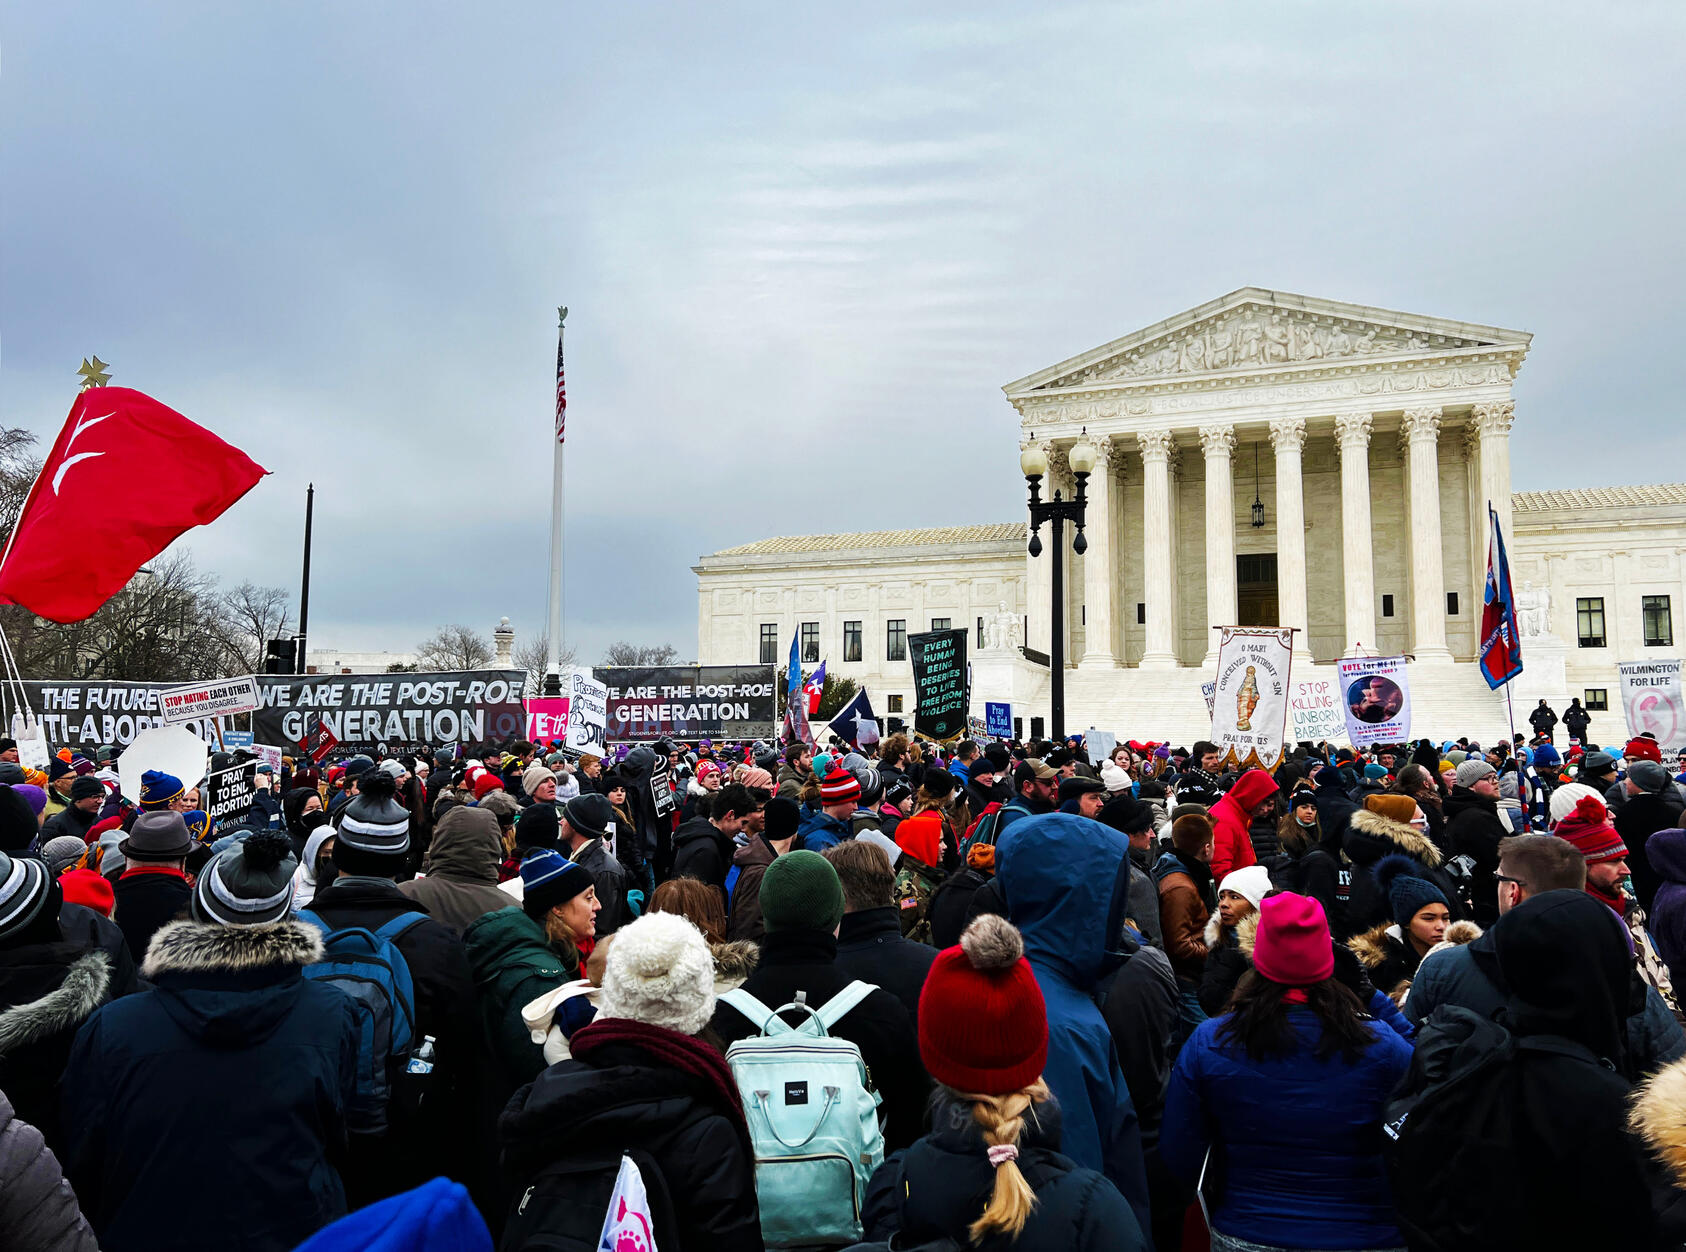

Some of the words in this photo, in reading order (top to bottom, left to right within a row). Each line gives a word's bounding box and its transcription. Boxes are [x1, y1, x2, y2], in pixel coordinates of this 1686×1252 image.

[924, 638, 952, 652] EVERY
[924, 649, 955, 663] HUMAN
[927, 660, 952, 674] BEING
[1342, 664, 1361, 672] VOTE
[1620, 664, 1680, 675] WILMINGTON
[921, 669, 960, 686] DESERVES
[1220, 656, 1246, 691] CONCEIVED
[1250, 654, 1278, 677] WITHOUT
[1273, 681, 1282, 696] SIN
[1630, 677, 1648, 686] FOR
[1650, 676, 1670, 686] LIFE
[257, 685, 291, 707] WE
[296, 684, 344, 706] ARE
[350, 683, 393, 705] THE
[396, 680, 524, 705] POST-ROE
[624, 687, 656, 699] ARE
[661, 685, 691, 698] THE
[696, 684, 773, 698] POST-ROE
[926, 687, 937, 696] TO
[940, 680, 956, 692] LIVE
[1299, 681, 1328, 695] STOP
[41, 688, 80, 710] THE
[86, 688, 160, 711] FUTURE
[165, 697, 183, 707] STOP
[184, 691, 209, 704] HATING
[210, 687, 228, 699] EACH
[228, 684, 251, 696] OTHER
[921, 696, 940, 708] FREE
[942, 690, 962, 702] FROM
[1292, 696, 1332, 709] KILLING
[167, 706, 194, 716] BECAUSE
[195, 703, 208, 711] YOU
[616, 703, 749, 722] GENERATION
[921, 701, 962, 716] VIOLENCE
[992, 704, 1004, 716] Pray
[990, 716, 995, 724] to
[997, 716, 1007, 726] End
[1294, 710, 1340, 724] UNBORN
[988, 725, 1010, 736] Abortion
[1295, 724, 1331, 738] BABIES
[1257, 737, 1268, 745] US
[222, 768, 244, 786] PRAY
[217, 787, 230, 801] TO
